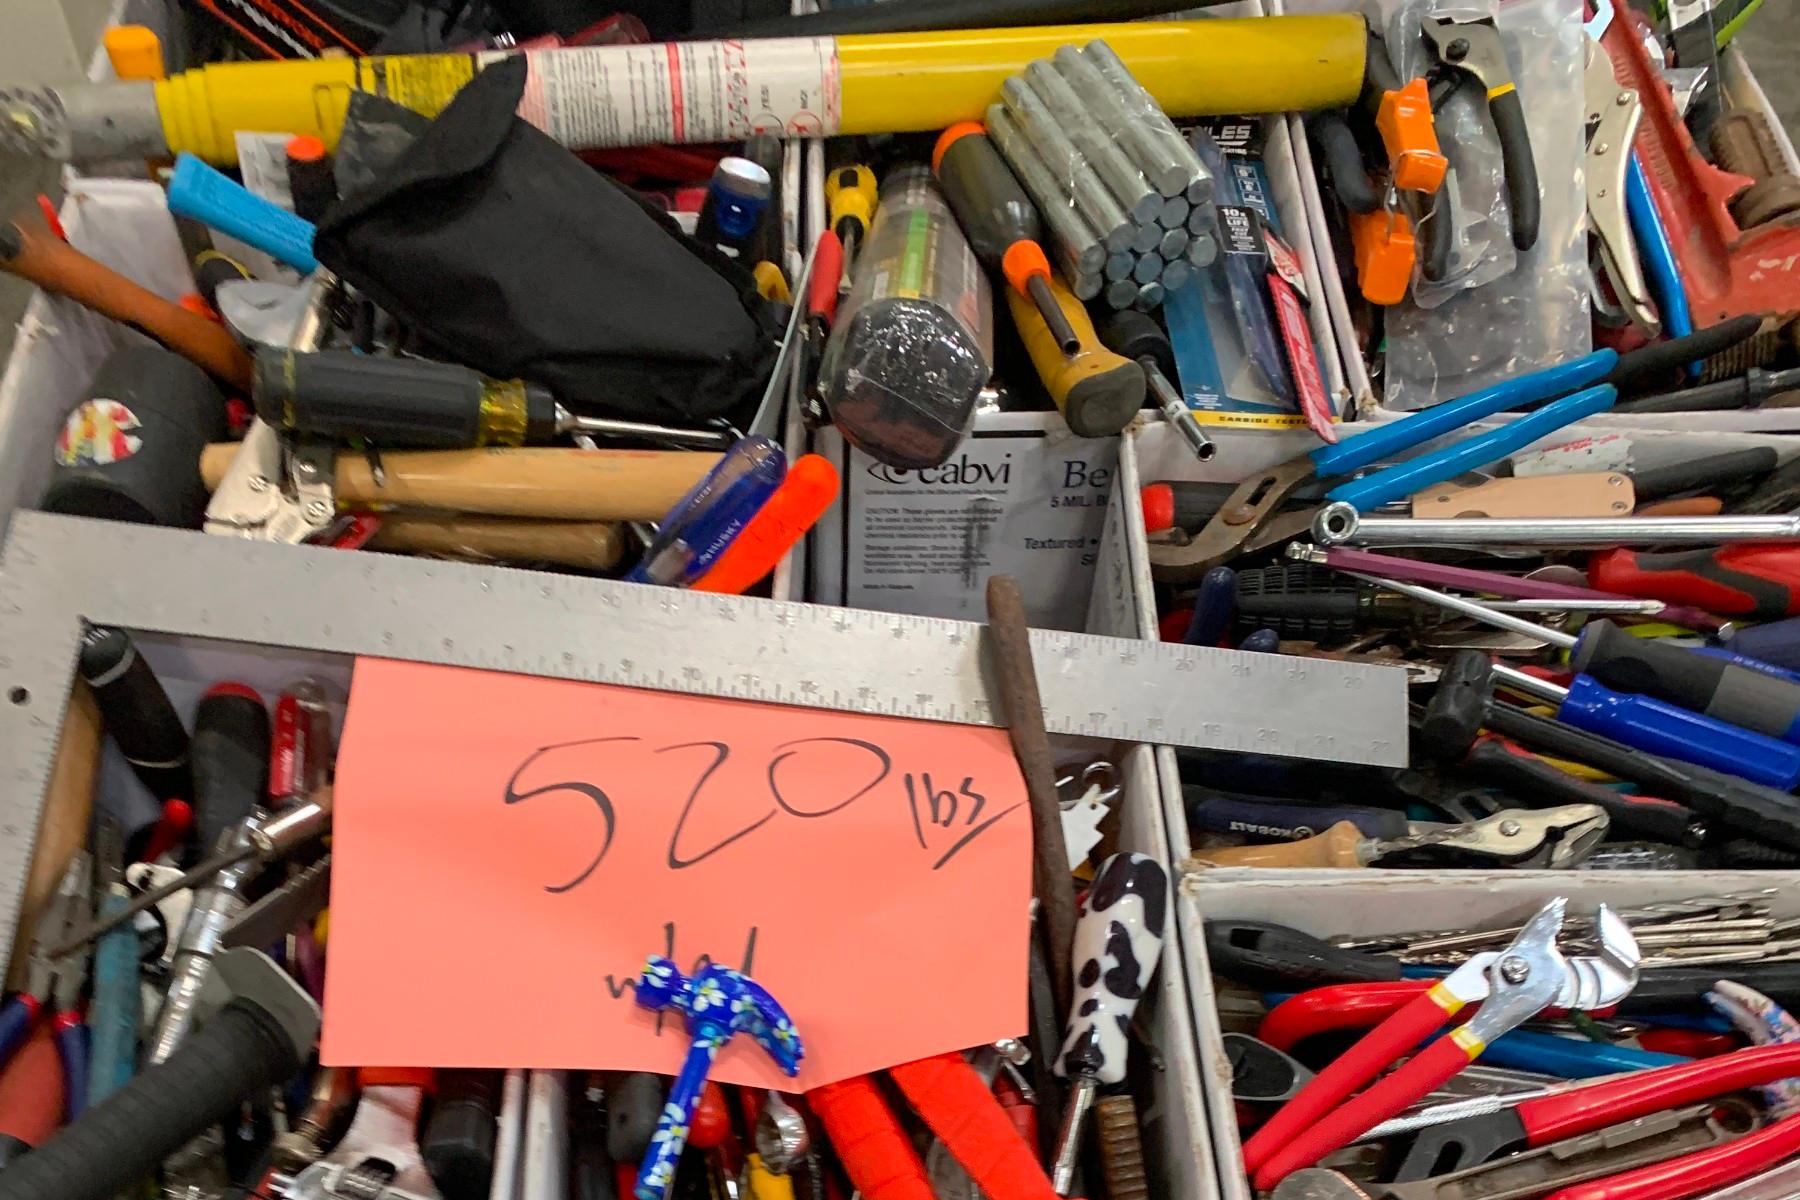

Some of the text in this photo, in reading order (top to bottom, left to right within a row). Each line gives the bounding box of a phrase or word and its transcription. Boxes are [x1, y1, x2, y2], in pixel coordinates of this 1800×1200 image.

[1219, 416, 1270, 424] CARBIDE
[919, 453, 1012, 485] cabvi
[706, 518, 743, 560] HUSKY
[1023, 537, 1086, 550] Textured
[504, 735, 891, 894] 520
[1229, 821, 1292, 838] KOBALT
